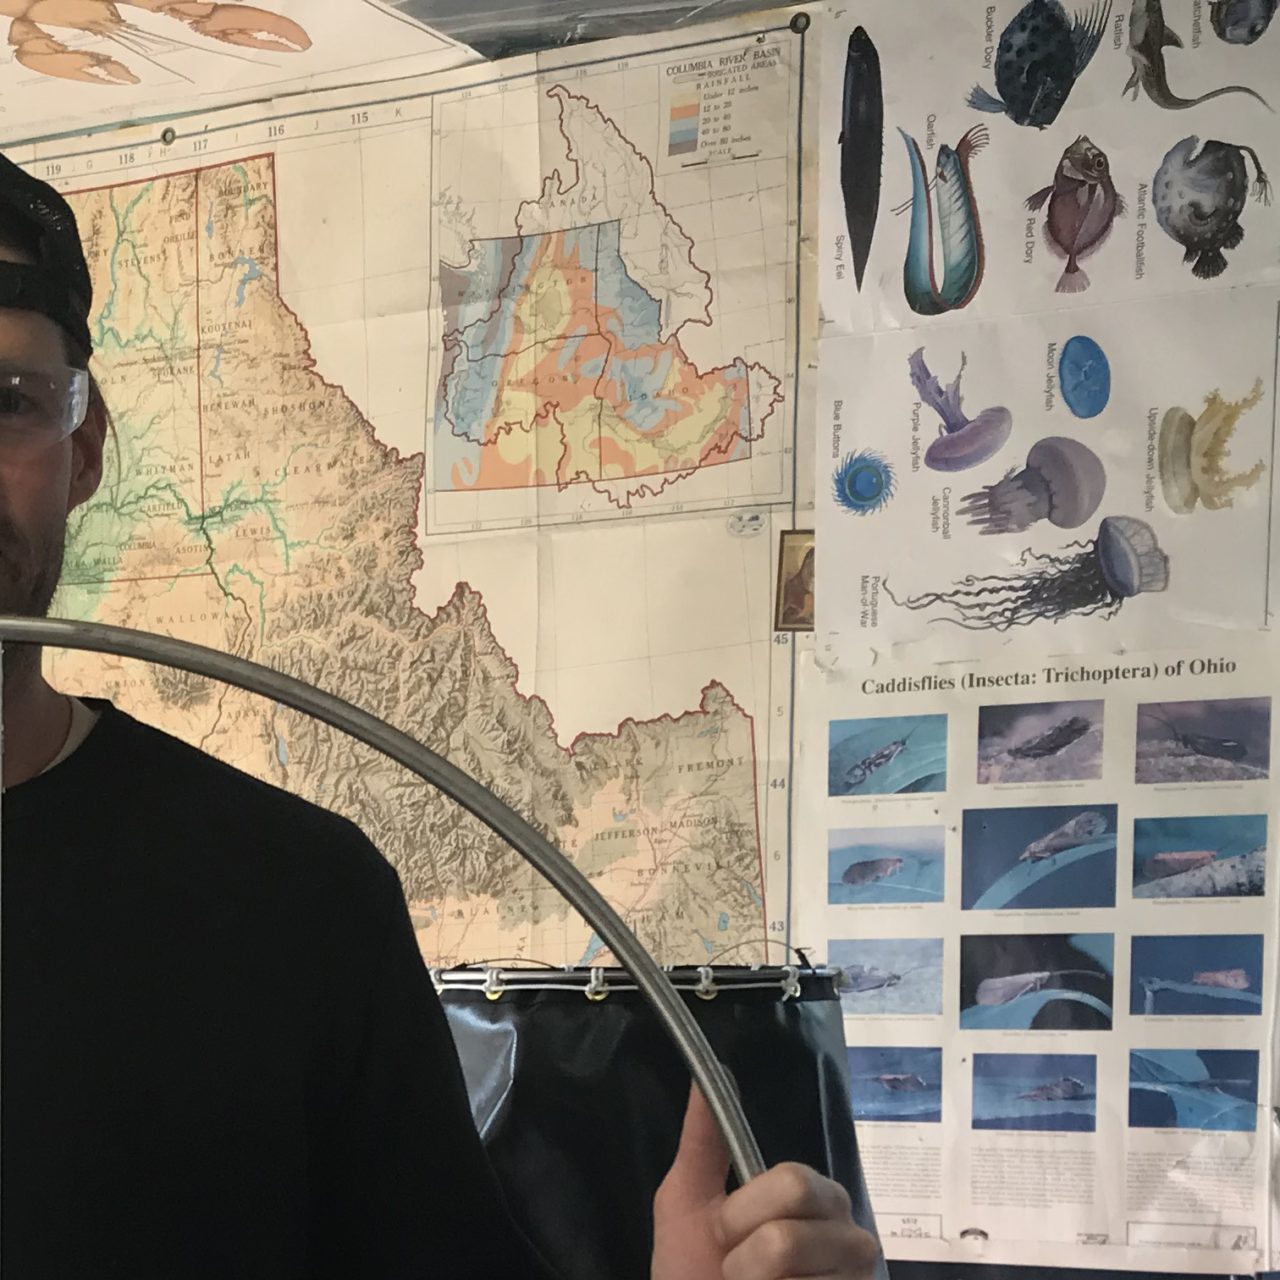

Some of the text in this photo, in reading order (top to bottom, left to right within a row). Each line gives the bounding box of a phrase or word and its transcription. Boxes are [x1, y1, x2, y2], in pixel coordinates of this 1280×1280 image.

[983, 6, 996, 70] Buckler Dory
[1114, 14, 1124, 50] Ratfish
[666, 47, 781, 77] COLUMBIA RIVER BASIN
[751, 60, 777, 71] AREAS
[696, 74, 752, 90] RAINFALL
[46, 164, 62, 176] 119
[119, 153, 136, 166] 118
[192, 139, 209, 152] 117
[267, 125, 285, 138] 116
[350, 112, 368, 125] 115
[927, 114, 936, 150] Oarfish
[1138, 183, 1148, 220] Atlantic
[834, 235, 845, 280] Spiny Eel
[1024, 218, 1036, 264] Red Dory
[1045, 342, 1057, 412] Moon Jellyfish
[832, 400, 843, 458] Blue Buttons
[912, 402, 921, 472] Purple Jellyfish
[1144, 407, 1158, 512] Upside-down Jellyfish
[931, 496, 939, 534] Jellyfish
[942, 486, 952, 540] Cannonball
[871, 576, 881, 628] Portuguese
[774, 632, 790, 646] 45
[861, 656, 1237, 696] Caddisflies (Insecta: Trichoptera) of Ohio
[677, 756, 745, 774] FREMONT
[770, 778, 786, 792] 44
[593, 826, 658, 842] JEFFERSON
[768, 920, 786, 934] 43
